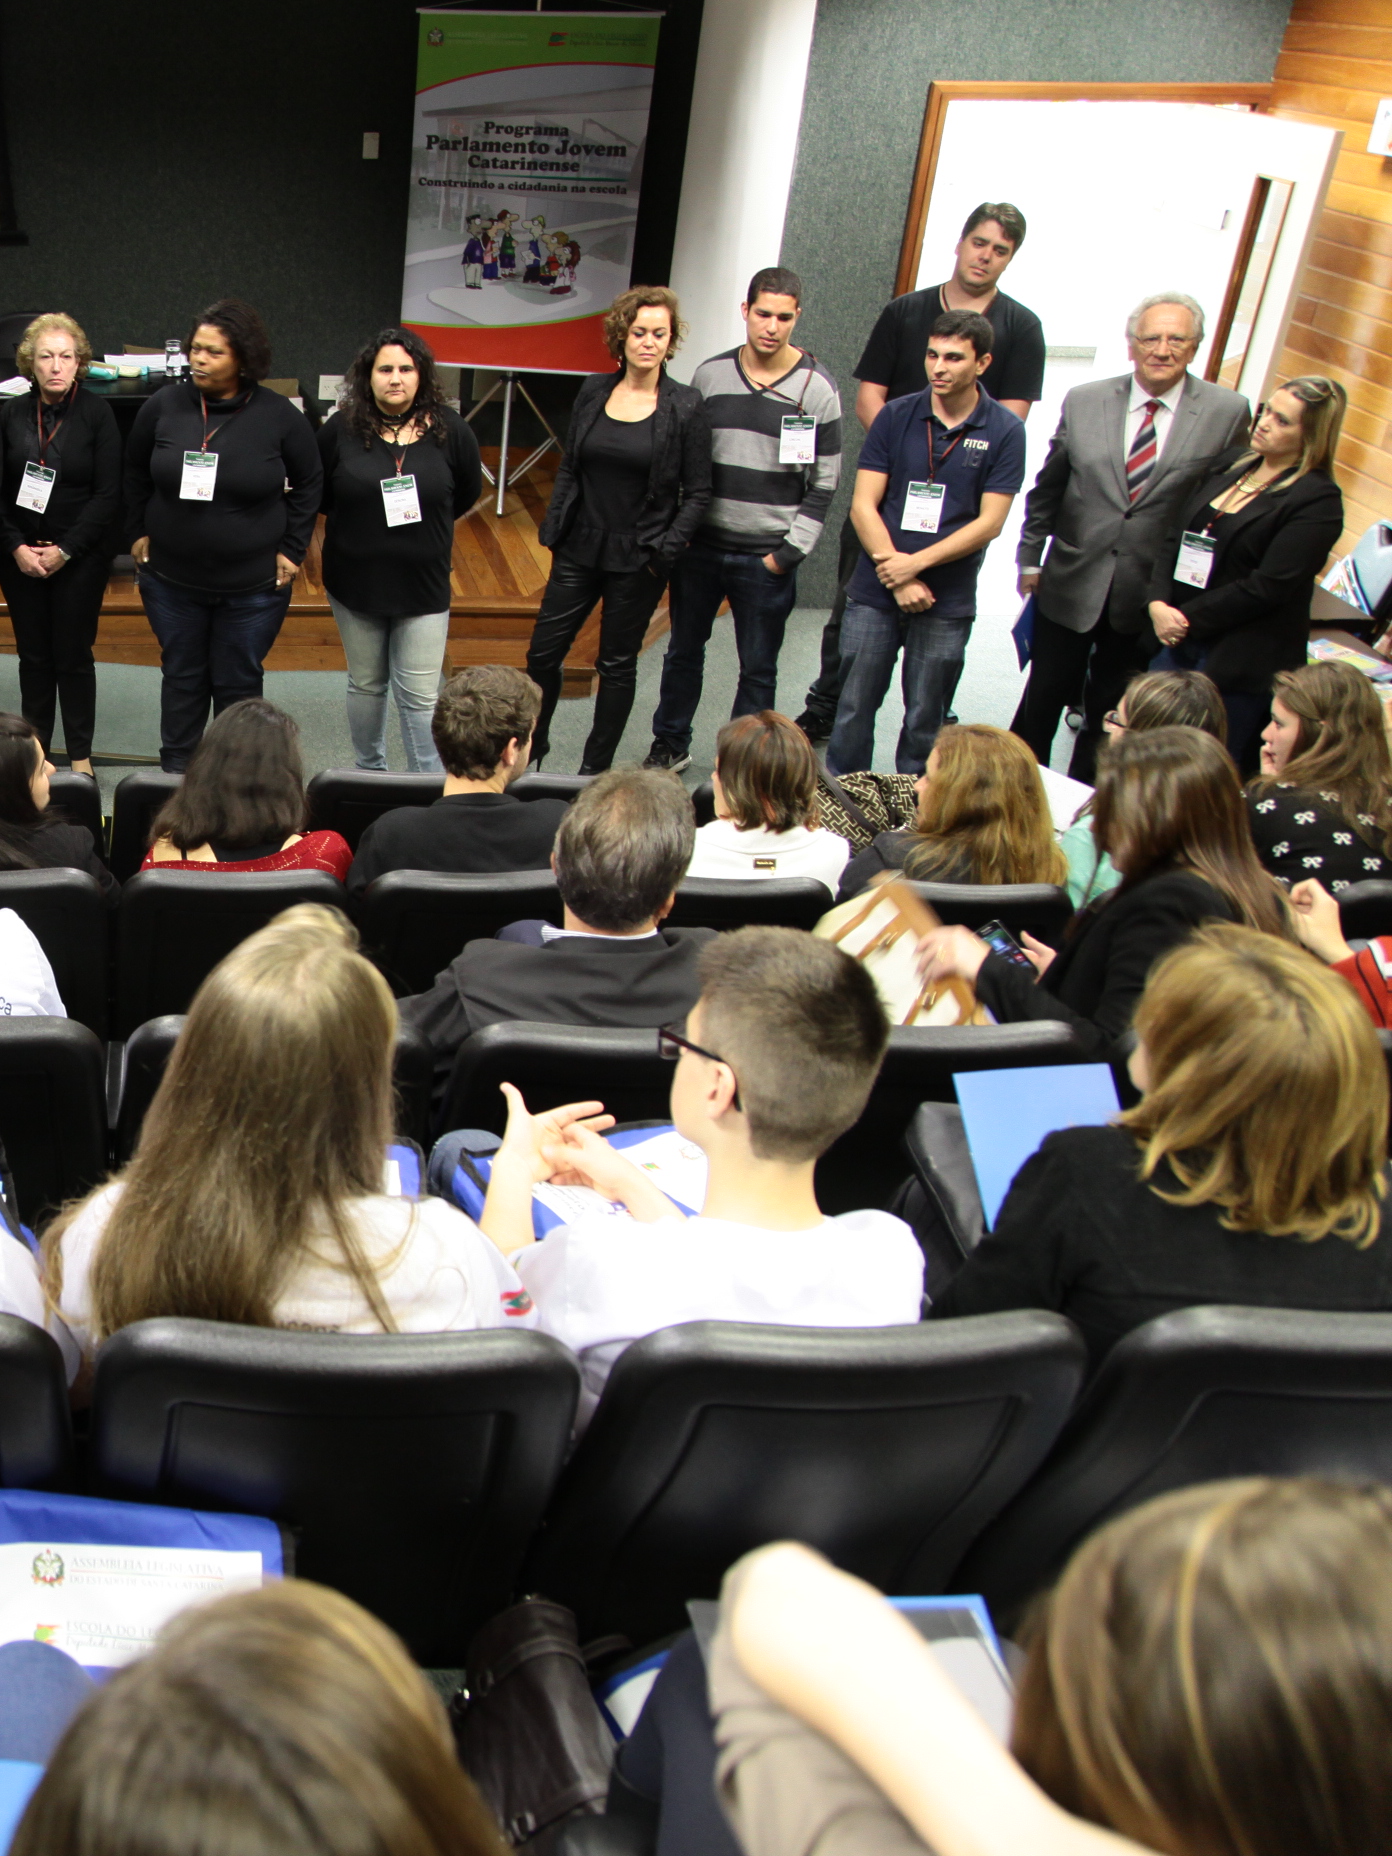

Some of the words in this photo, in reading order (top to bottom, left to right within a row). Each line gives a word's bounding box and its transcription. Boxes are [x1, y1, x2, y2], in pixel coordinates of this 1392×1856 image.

[484, 121, 569, 138] Programa
[425, 135, 550, 155] Parlamento
[555, 140, 627, 157] Jovem
[468, 155, 580, 172] Catarinense
[418, 177, 495, 190] Construindo
[498, 182, 505, 190] a
[508, 180, 568, 193] cidadania
[571, 185, 586, 194] na
[589, 184, 627, 195] escola
[963, 439, 990, 450] FITCH
[71, 1556, 143, 1571] ASSEMBLEIA
[147, 1560, 224, 1577] LEGISLATIVA
[66, 1620, 114, 1636] ESCOLA
[117, 1625, 136, 1637] DO
